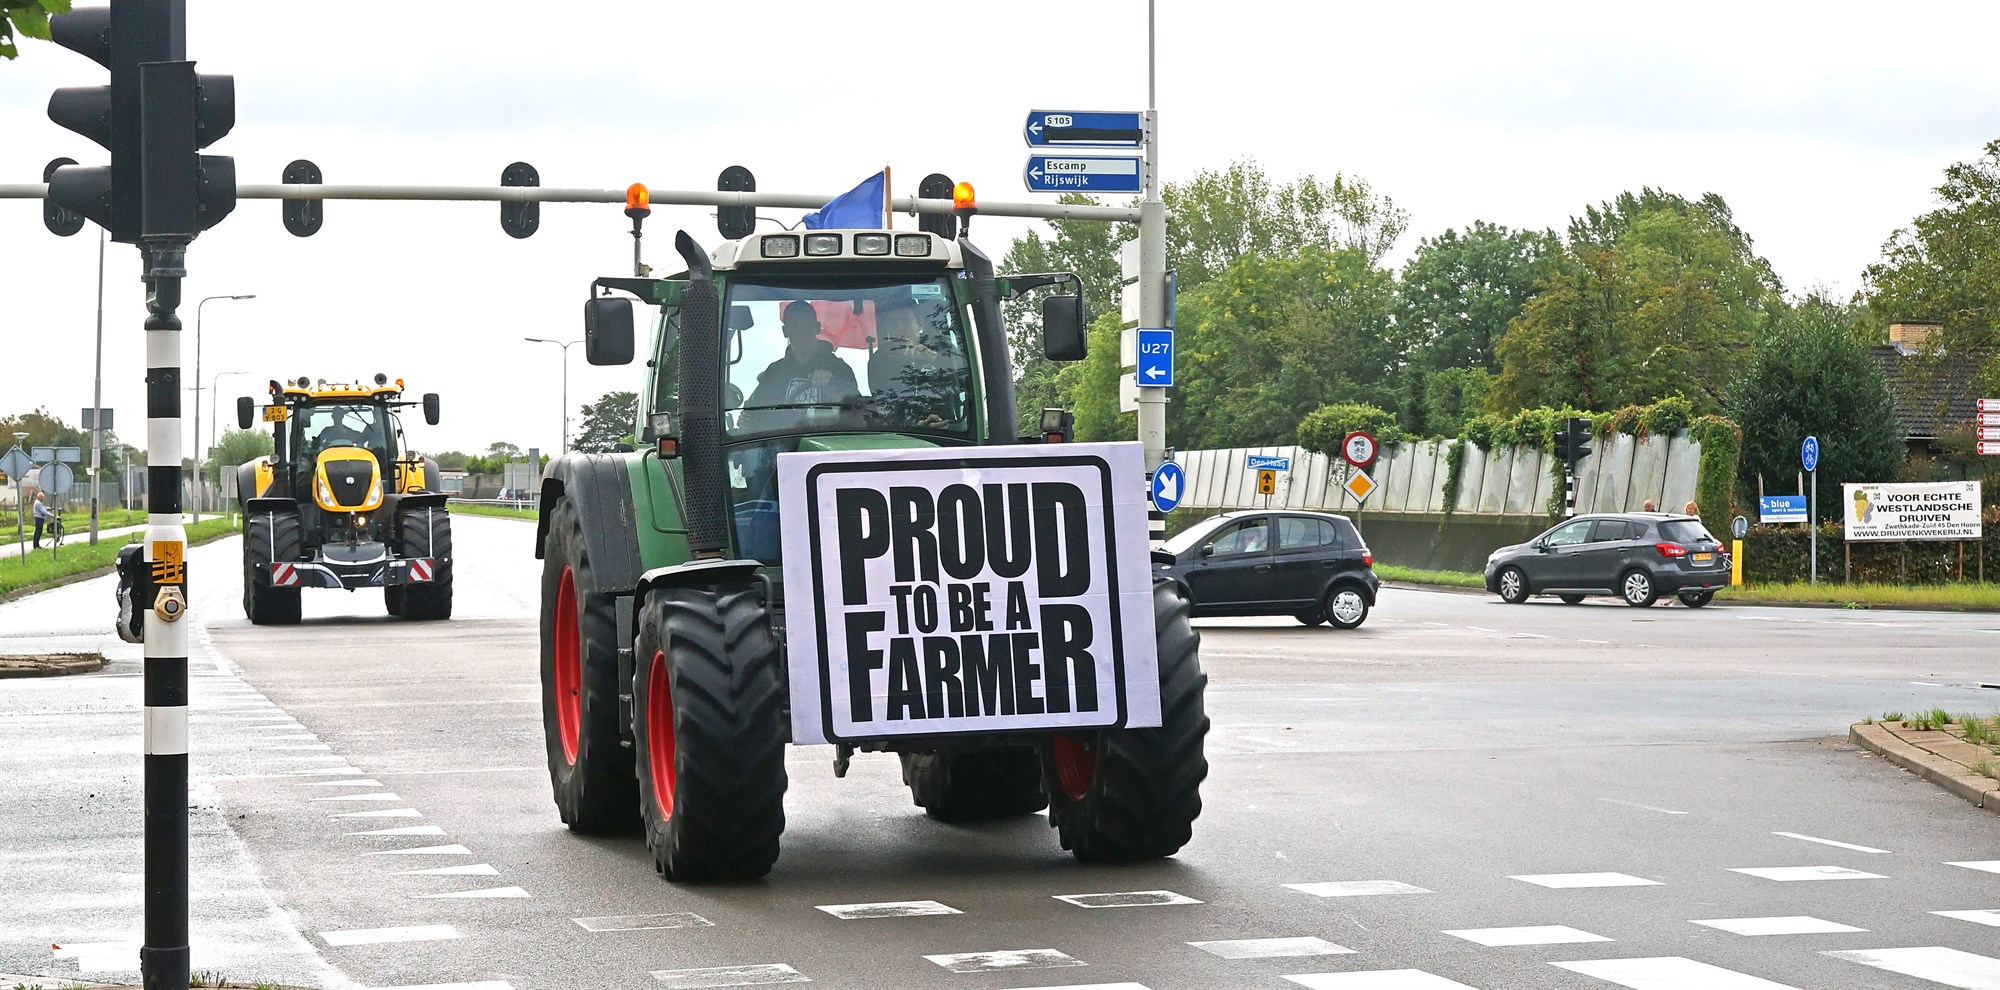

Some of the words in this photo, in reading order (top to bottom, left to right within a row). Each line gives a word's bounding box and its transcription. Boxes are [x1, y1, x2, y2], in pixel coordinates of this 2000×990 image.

[1047, 117, 1052, 125] S
[1054, 117, 1070, 125] 105
[1047, 161, 1087, 172] Escamp
[1044, 175, 1089, 187] Rijswijk
[1142, 343, 1169, 354] U27
[1251, 458, 1265, 466] Den
[1266, 459, 1286, 469] Haag
[1887, 494, 1920, 502] VOOR
[1923, 493, 1962, 501] ECHTE
[1771, 499, 1790, 508] blue
[1876, 503, 1973, 512] WESTLANDSCHE
[1899, 514, 1951, 522] DRUIVEN
[1853, 529, 1975, 537] WWW.DRUIVENKWEKERIJ.NL
[835, 482, 1091, 606] PROUD
[889, 584, 939, 634] TO
[947, 582, 994, 632] BE
[1005, 580, 1032, 630] A
[844, 604, 1099, 723] FARMER
